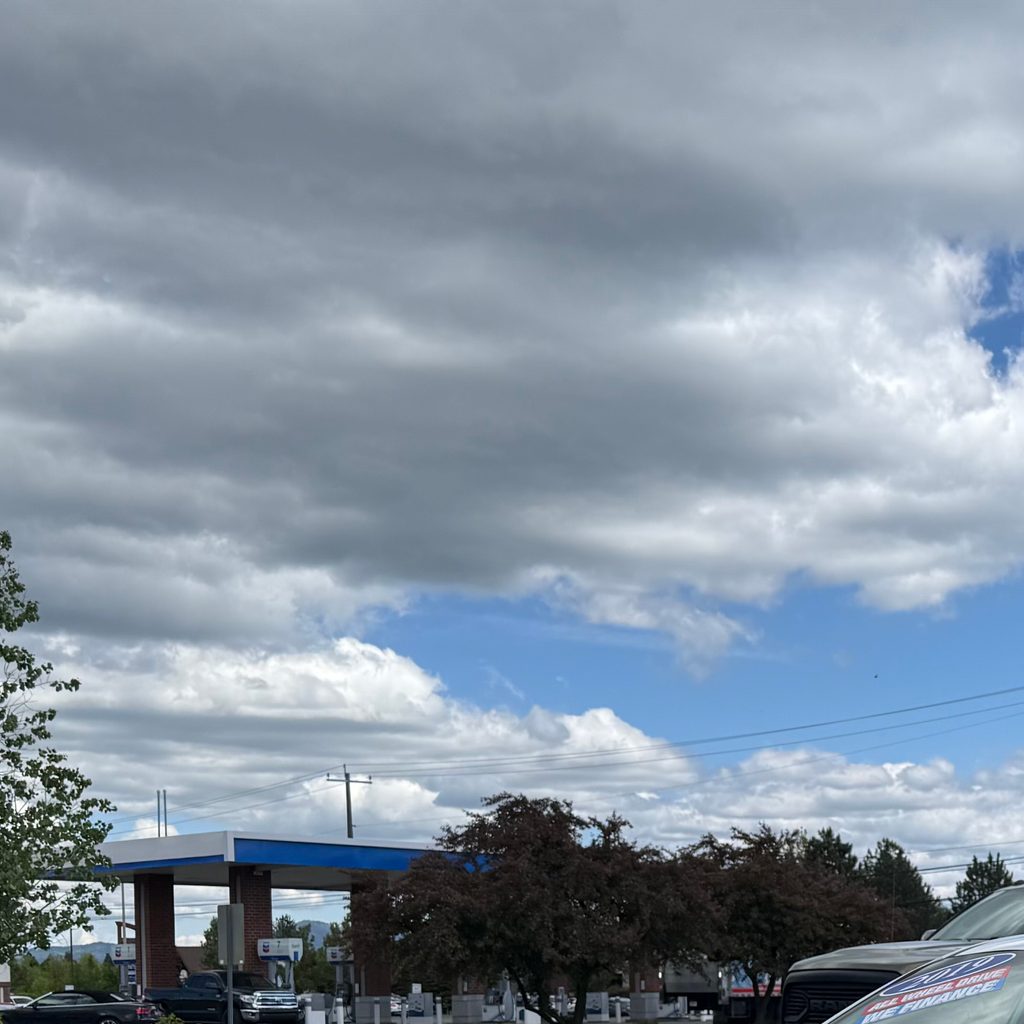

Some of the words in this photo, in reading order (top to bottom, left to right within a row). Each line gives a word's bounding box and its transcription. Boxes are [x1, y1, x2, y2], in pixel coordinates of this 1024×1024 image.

[862, 1005, 899, 1024] WE
[899, 980, 998, 1014] FINANCE
[868, 996, 898, 1012] ALL
[901, 981, 953, 1002] WHEEL
[955, 967, 1006, 987] DRIVE
